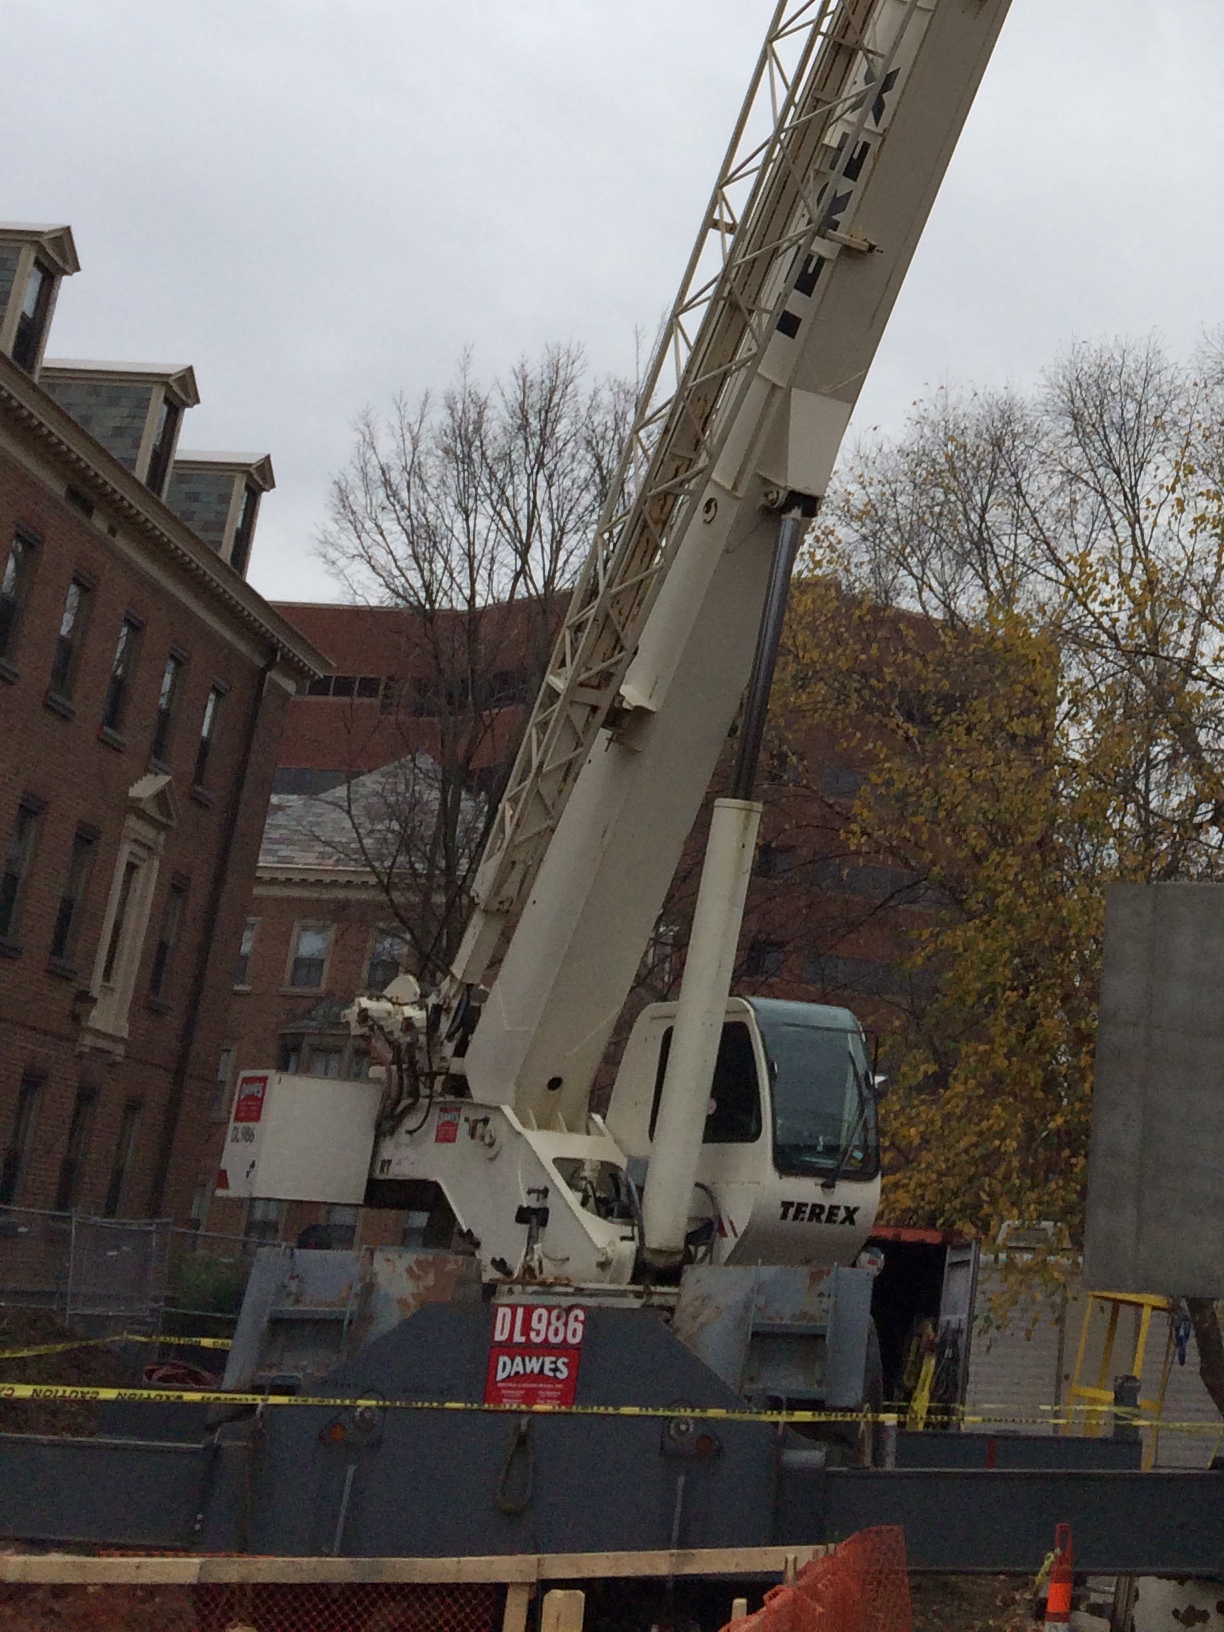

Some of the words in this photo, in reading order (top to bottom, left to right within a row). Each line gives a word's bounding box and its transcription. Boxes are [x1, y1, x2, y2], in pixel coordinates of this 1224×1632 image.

[780, 1200, 860, 1226] TEREX
[493, 1306, 585, 1345] DL986
[495, 1355, 570, 1382] DAWES
[30, 1387, 101, 1401] CAUTION
